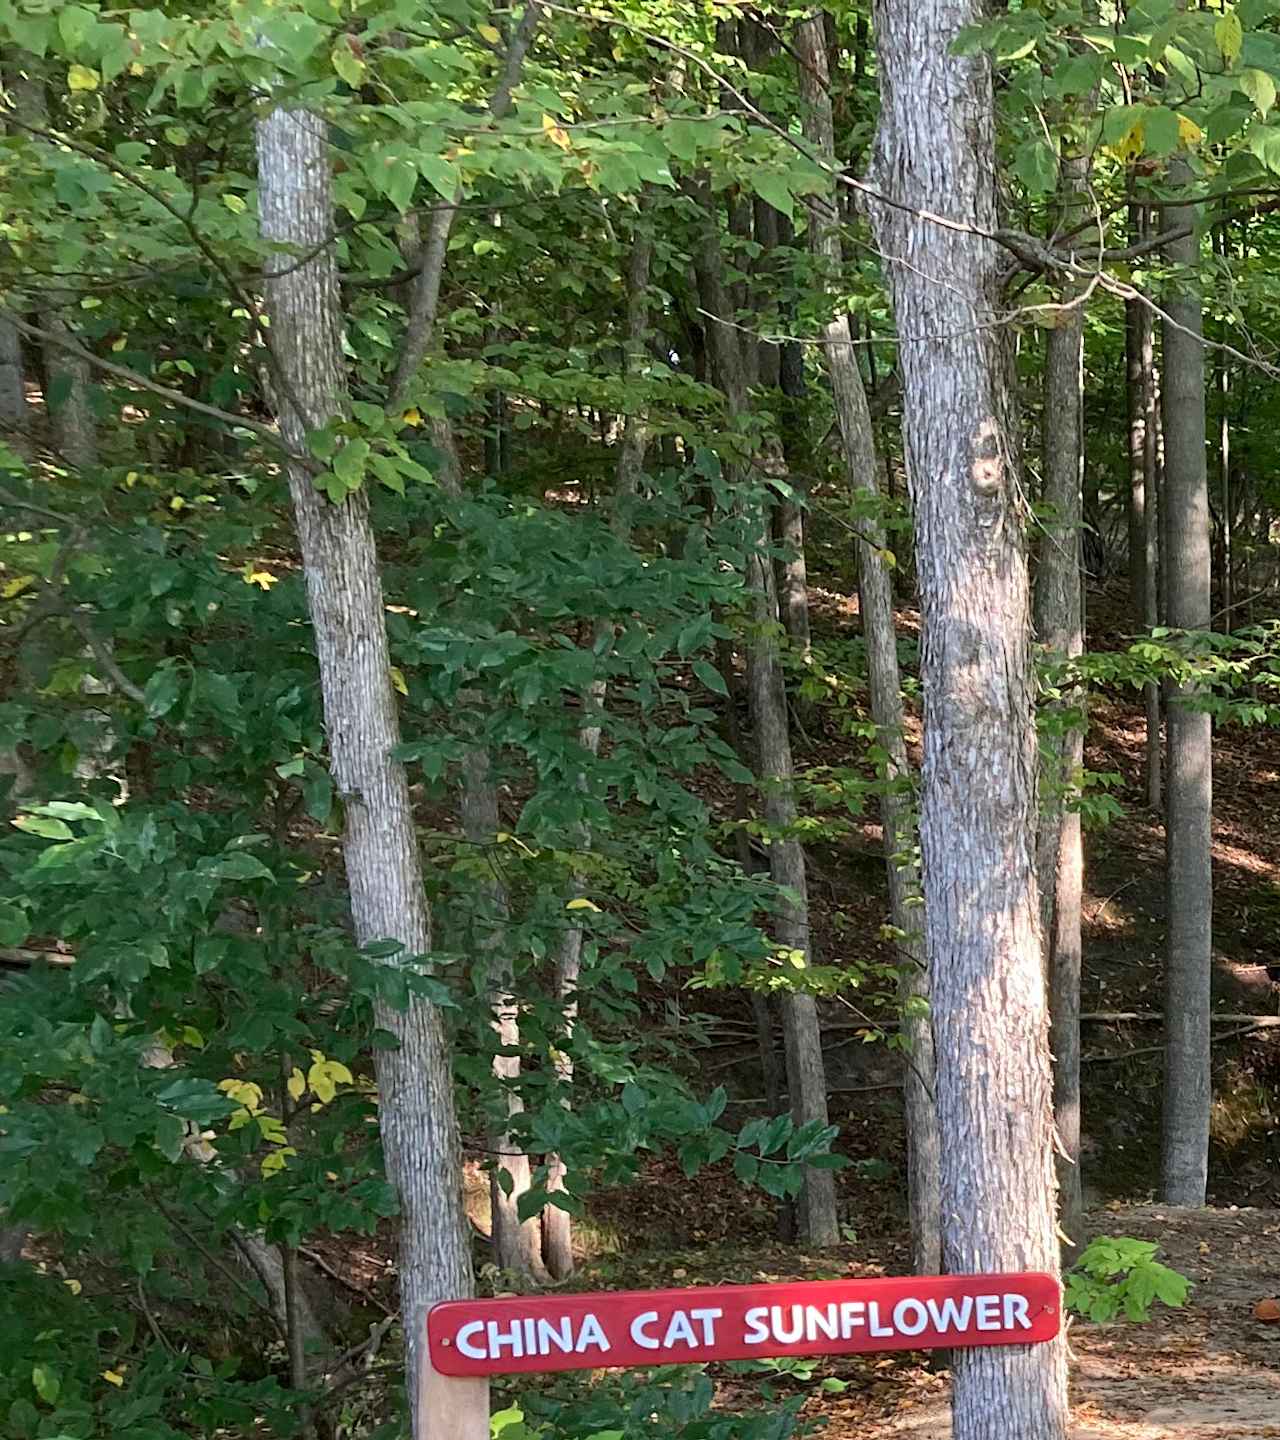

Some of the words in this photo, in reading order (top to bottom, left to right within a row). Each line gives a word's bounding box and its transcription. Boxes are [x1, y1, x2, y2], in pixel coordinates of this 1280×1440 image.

[456, 1313, 611, 1359] CHINA
[631, 1307, 723, 1349] CAT
[745, 1293, 1033, 1344] SUNFLOWER
